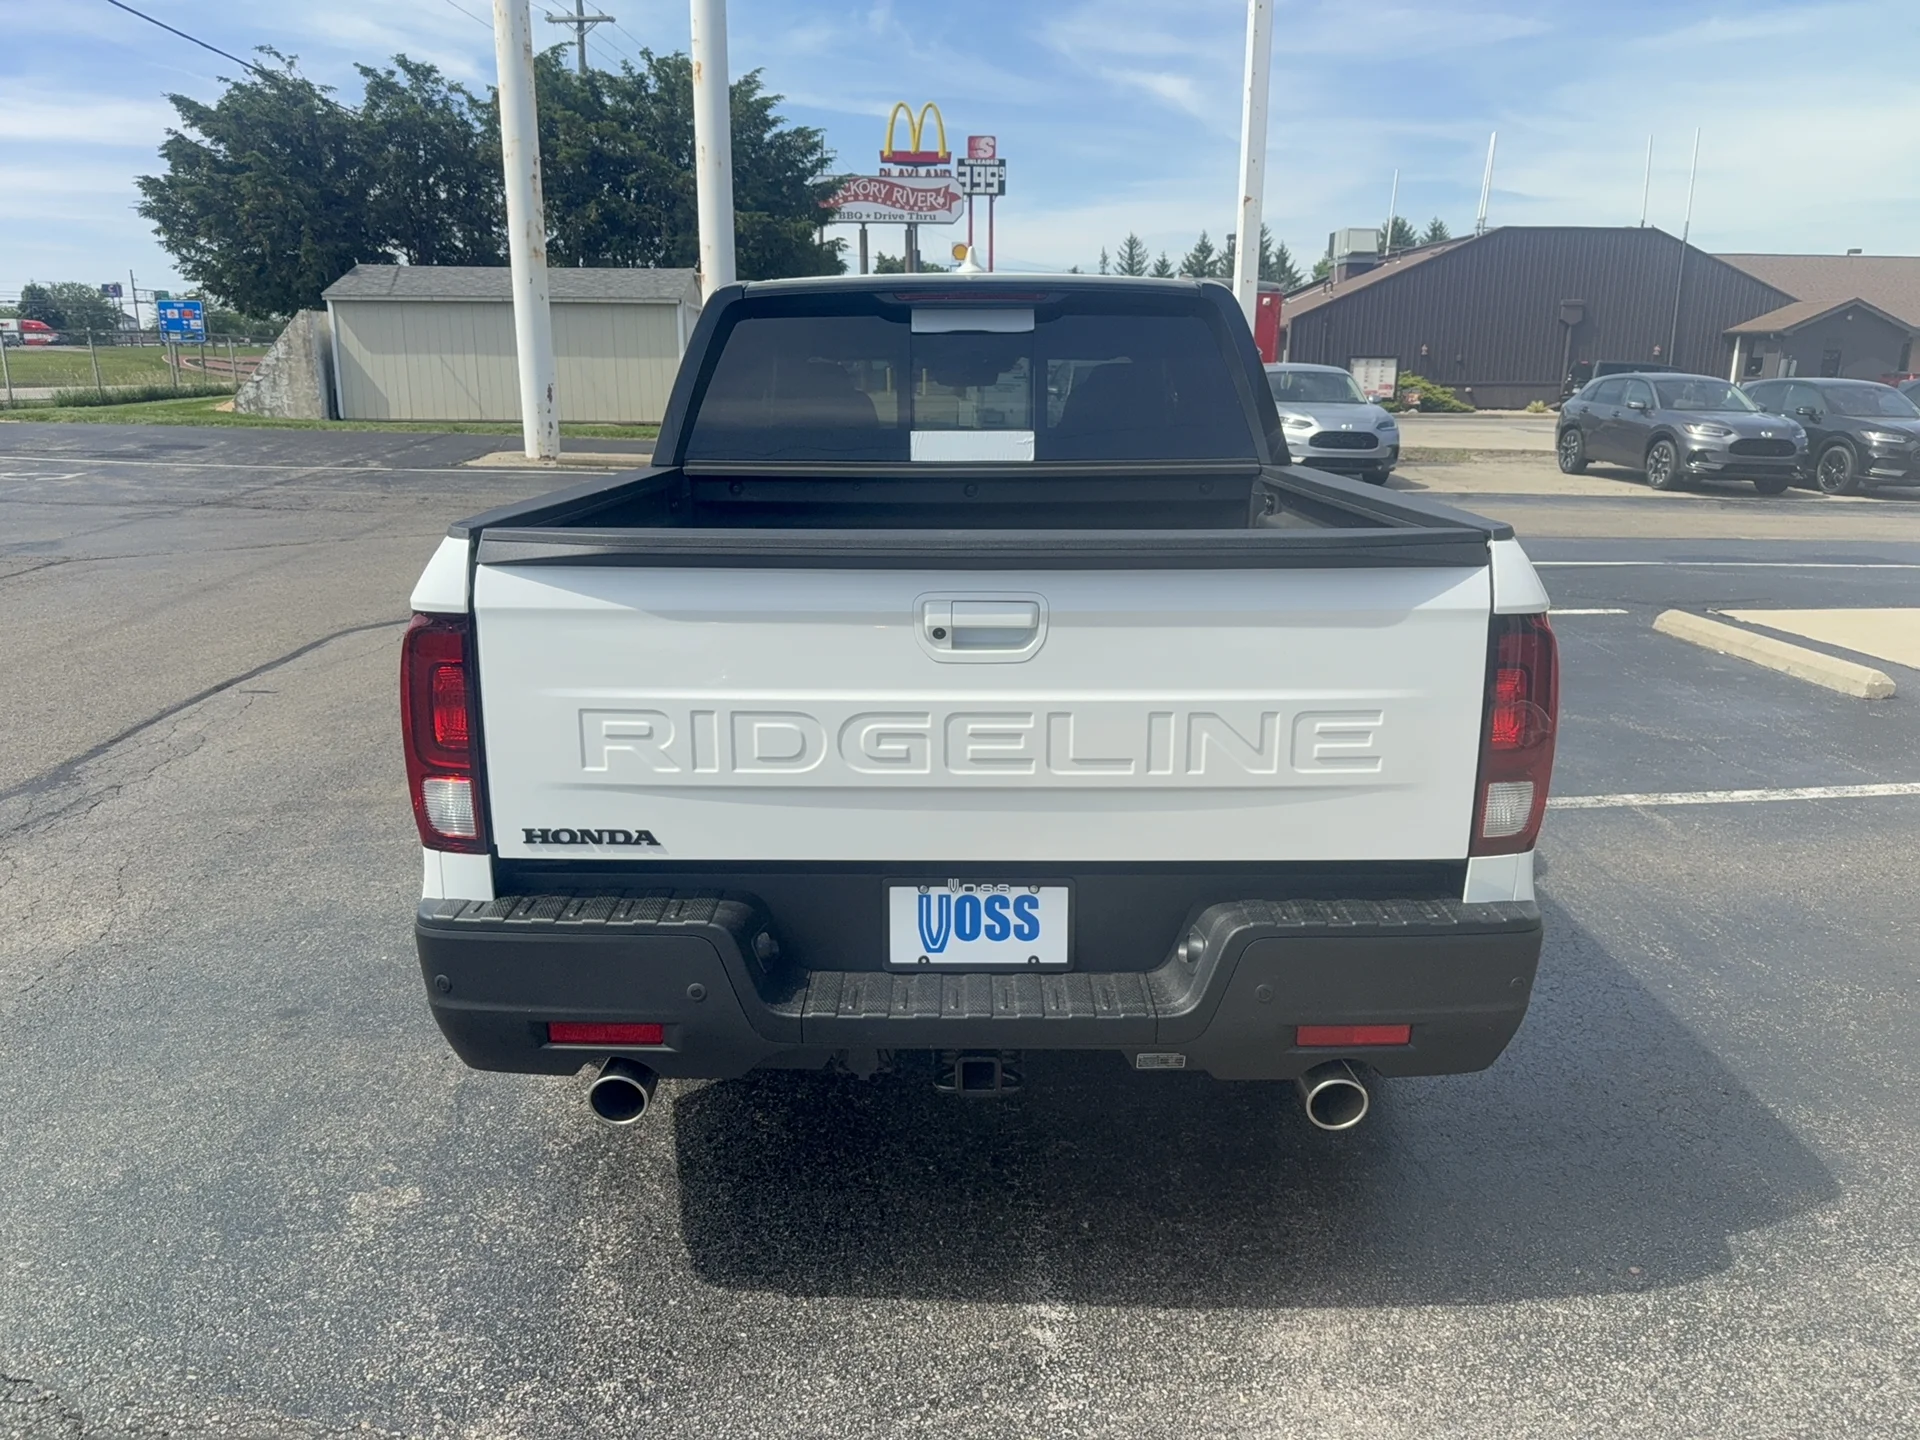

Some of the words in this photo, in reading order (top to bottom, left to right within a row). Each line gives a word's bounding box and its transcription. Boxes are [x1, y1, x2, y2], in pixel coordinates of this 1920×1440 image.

[839, 212, 863, 220] BBQ
[874, 212, 905, 220] Drive
[908, 212, 937, 220] Thru
[577, 708, 1386, 776] RIDGELINE
[522, 828, 661, 845] HONDA
[918, 894, 1040, 953] VOSS
